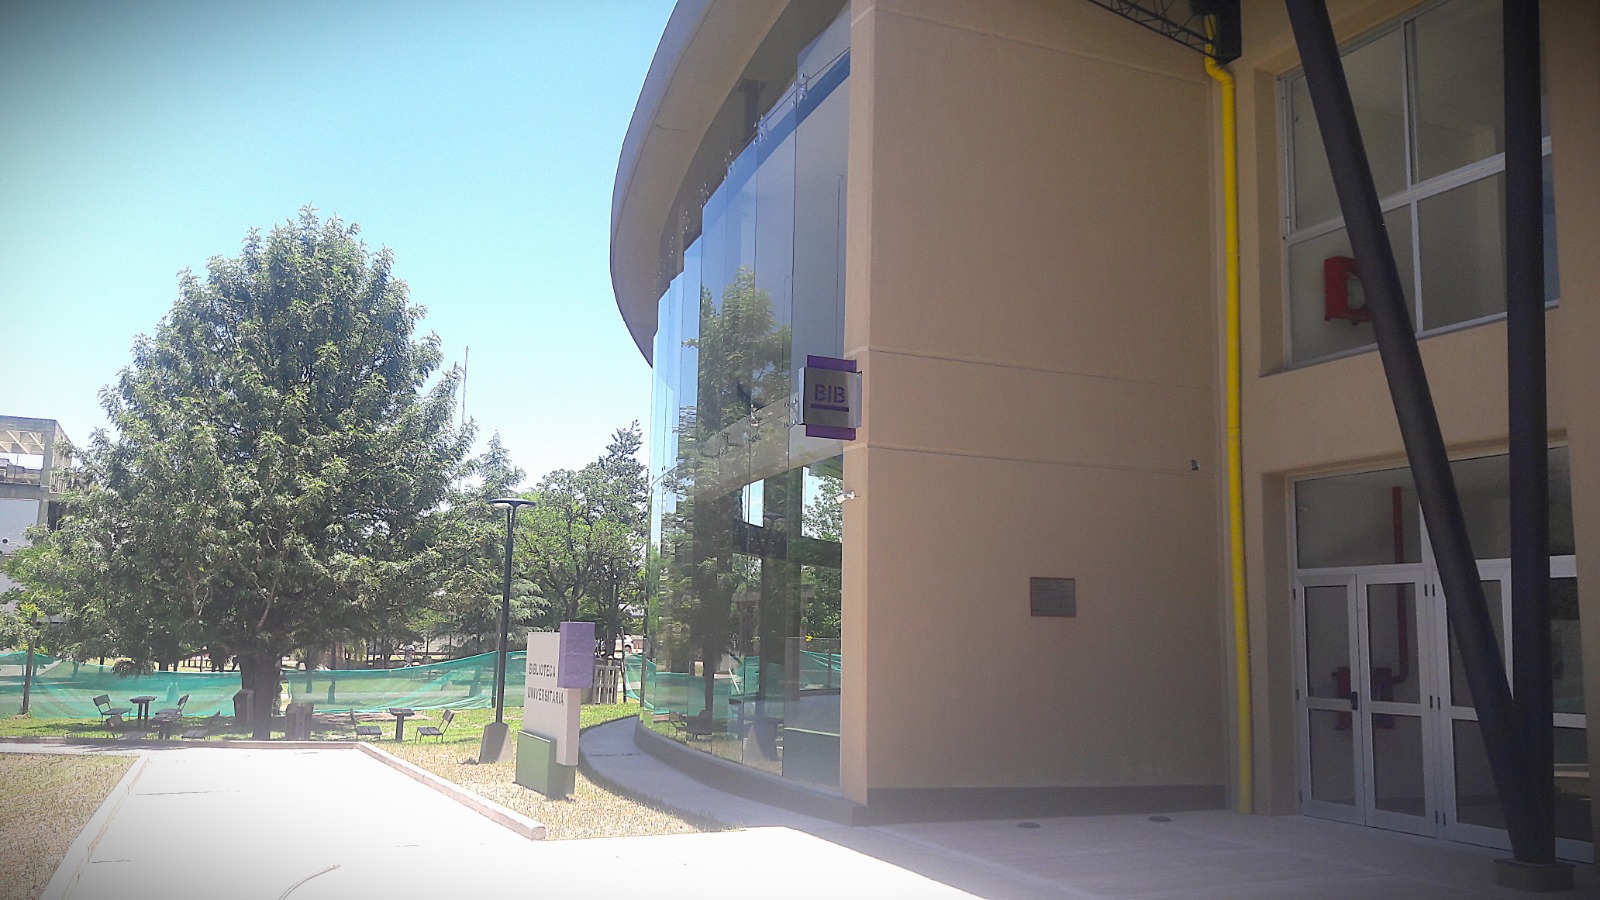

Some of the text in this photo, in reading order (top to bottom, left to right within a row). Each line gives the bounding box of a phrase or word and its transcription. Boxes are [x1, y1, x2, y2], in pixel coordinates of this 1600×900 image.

[815, 383, 845, 403] BIB
[528, 662, 556, 678] BIBLIOTECA
[527, 687, 564, 705] UNIVERSITARIA
